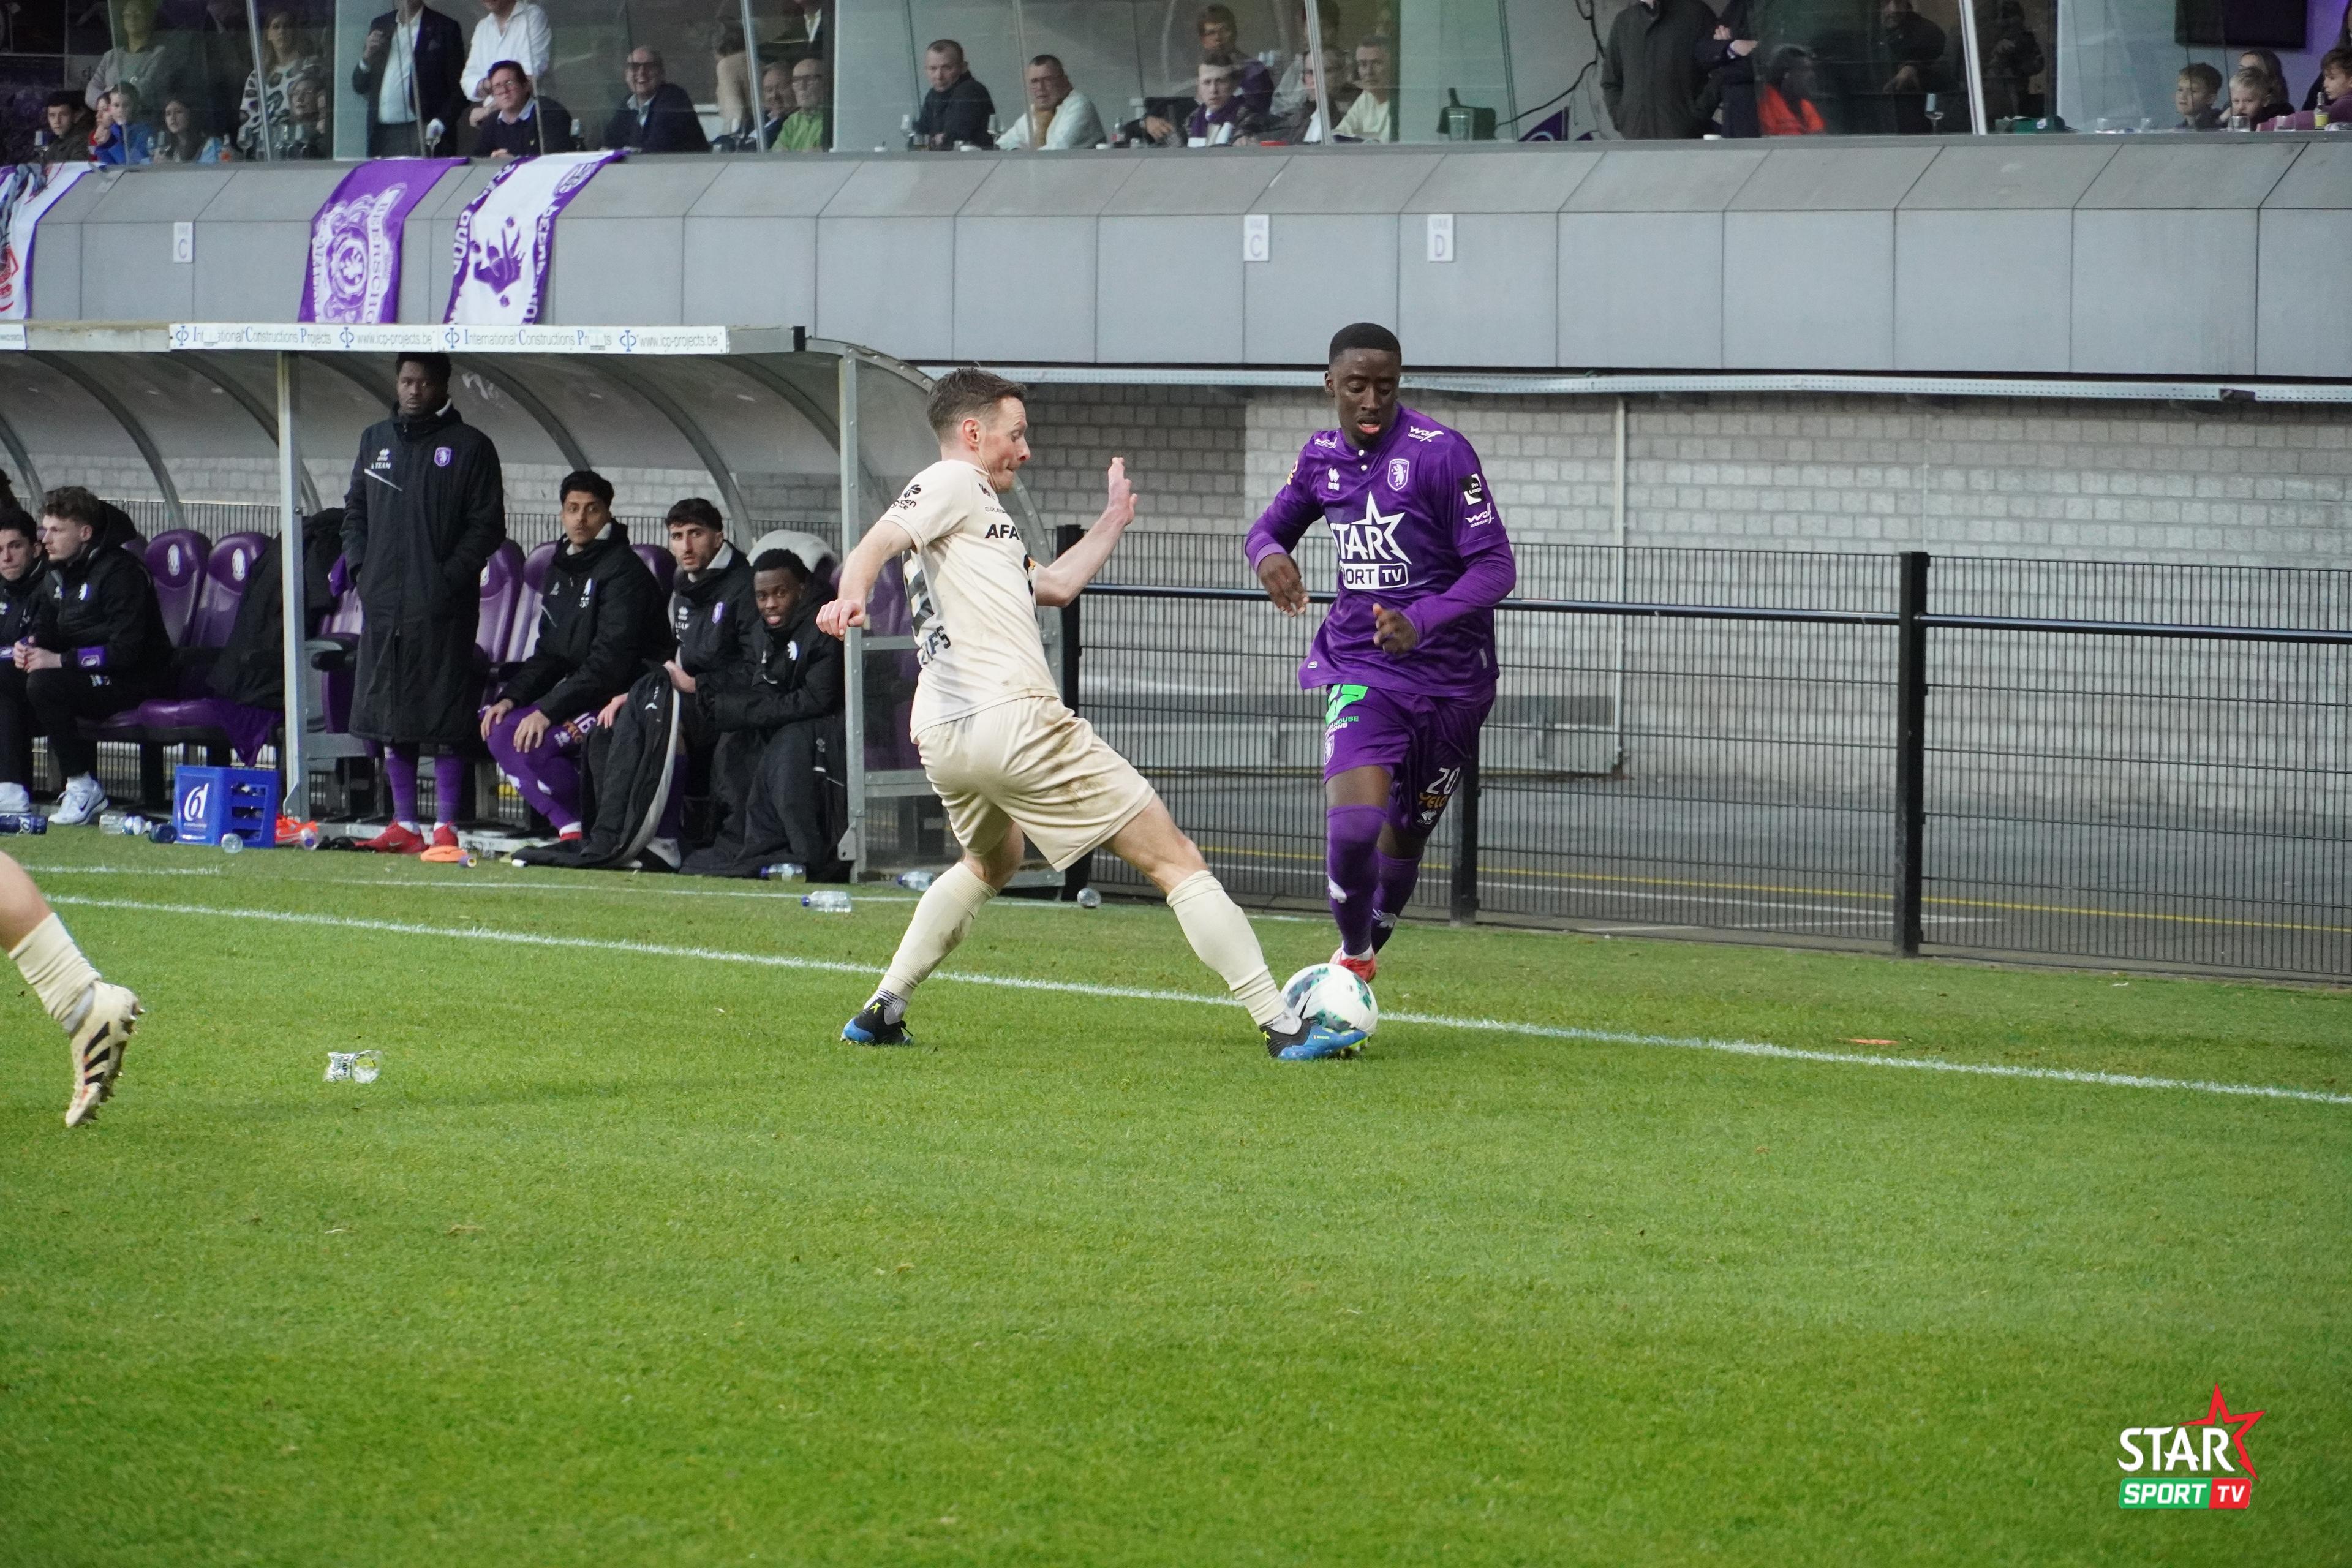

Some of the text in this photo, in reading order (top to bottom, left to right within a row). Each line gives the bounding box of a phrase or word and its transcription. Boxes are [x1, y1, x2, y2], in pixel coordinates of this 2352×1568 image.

[193, 326, 332, 347] Intational Constructions Projects
[357, 332, 432, 347] www.icp-projects.be
[464, 329, 516, 345] International
[519, 329, 575, 346] Constructions
[639, 333, 718, 351] www.icp-projects.be
[1341, 566, 1402, 584] ORT TV
[573, 712, 597, 734] 16
[1425, 766, 1460, 794] 20
